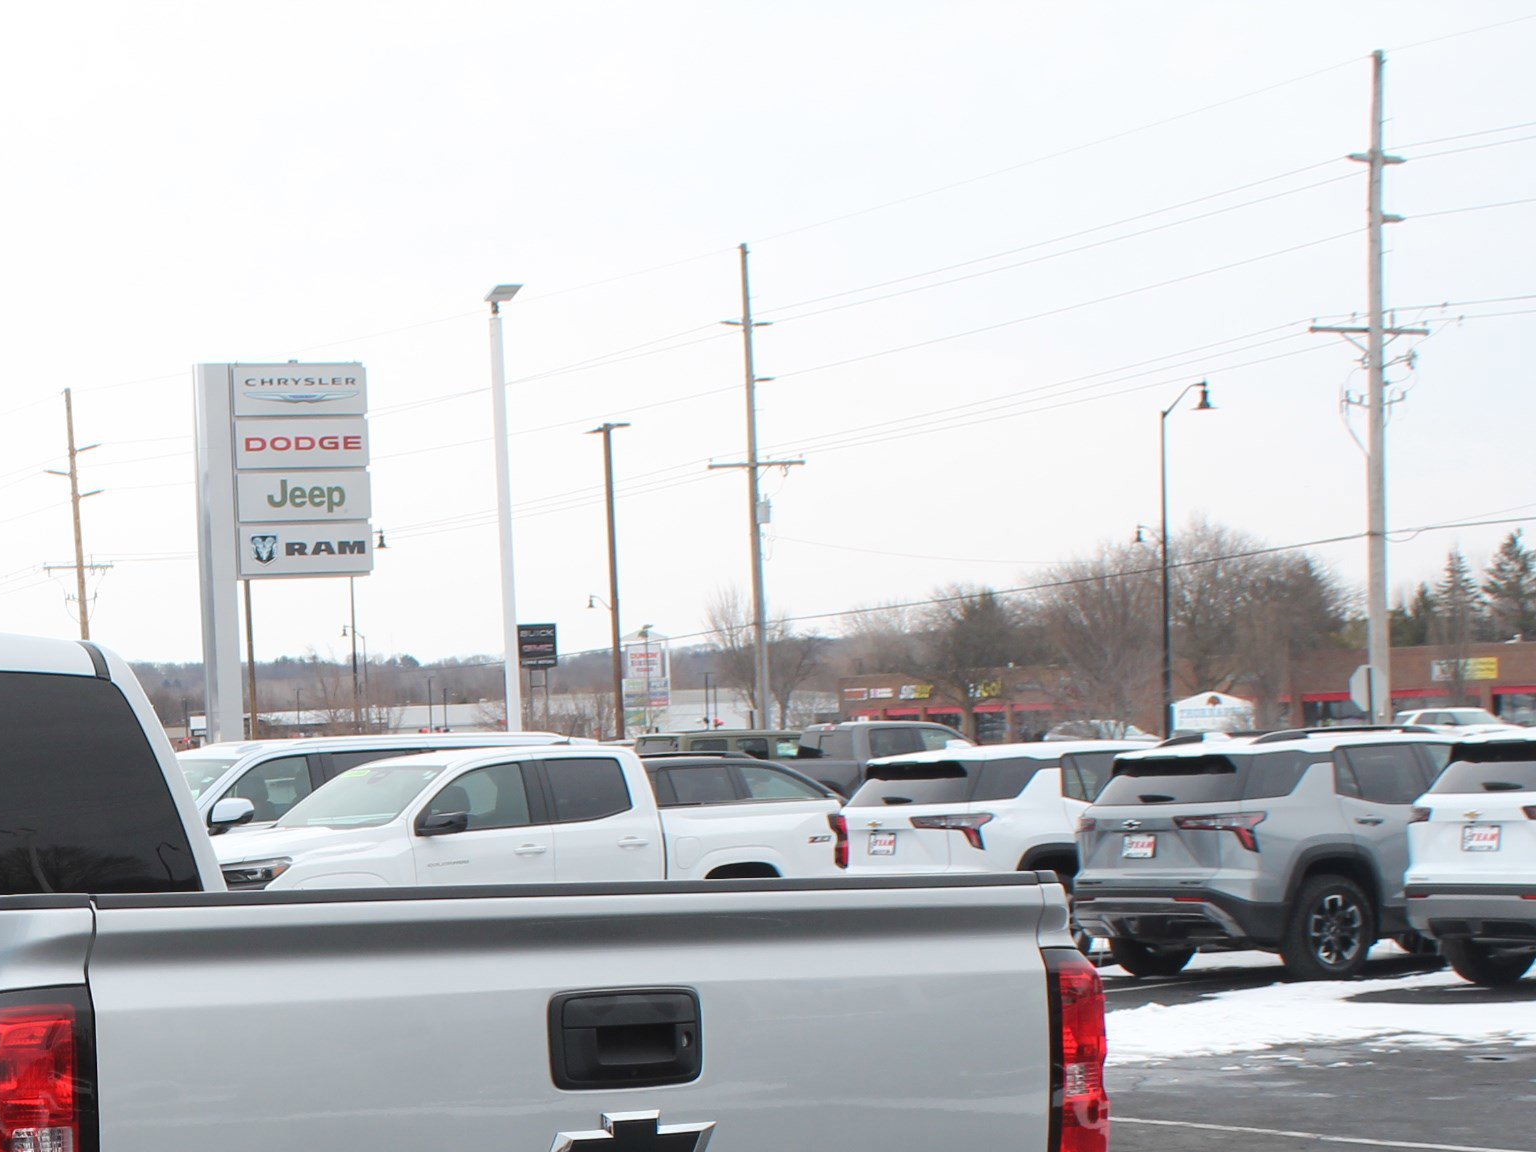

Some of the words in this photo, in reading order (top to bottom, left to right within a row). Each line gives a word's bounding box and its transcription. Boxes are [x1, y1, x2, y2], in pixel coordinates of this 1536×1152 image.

[244, 376, 357, 387] CHRYSLER
[244, 435, 363, 452] DODGE
[267, 479, 346, 513] Jeep
[285, 540, 366, 556] RAM
